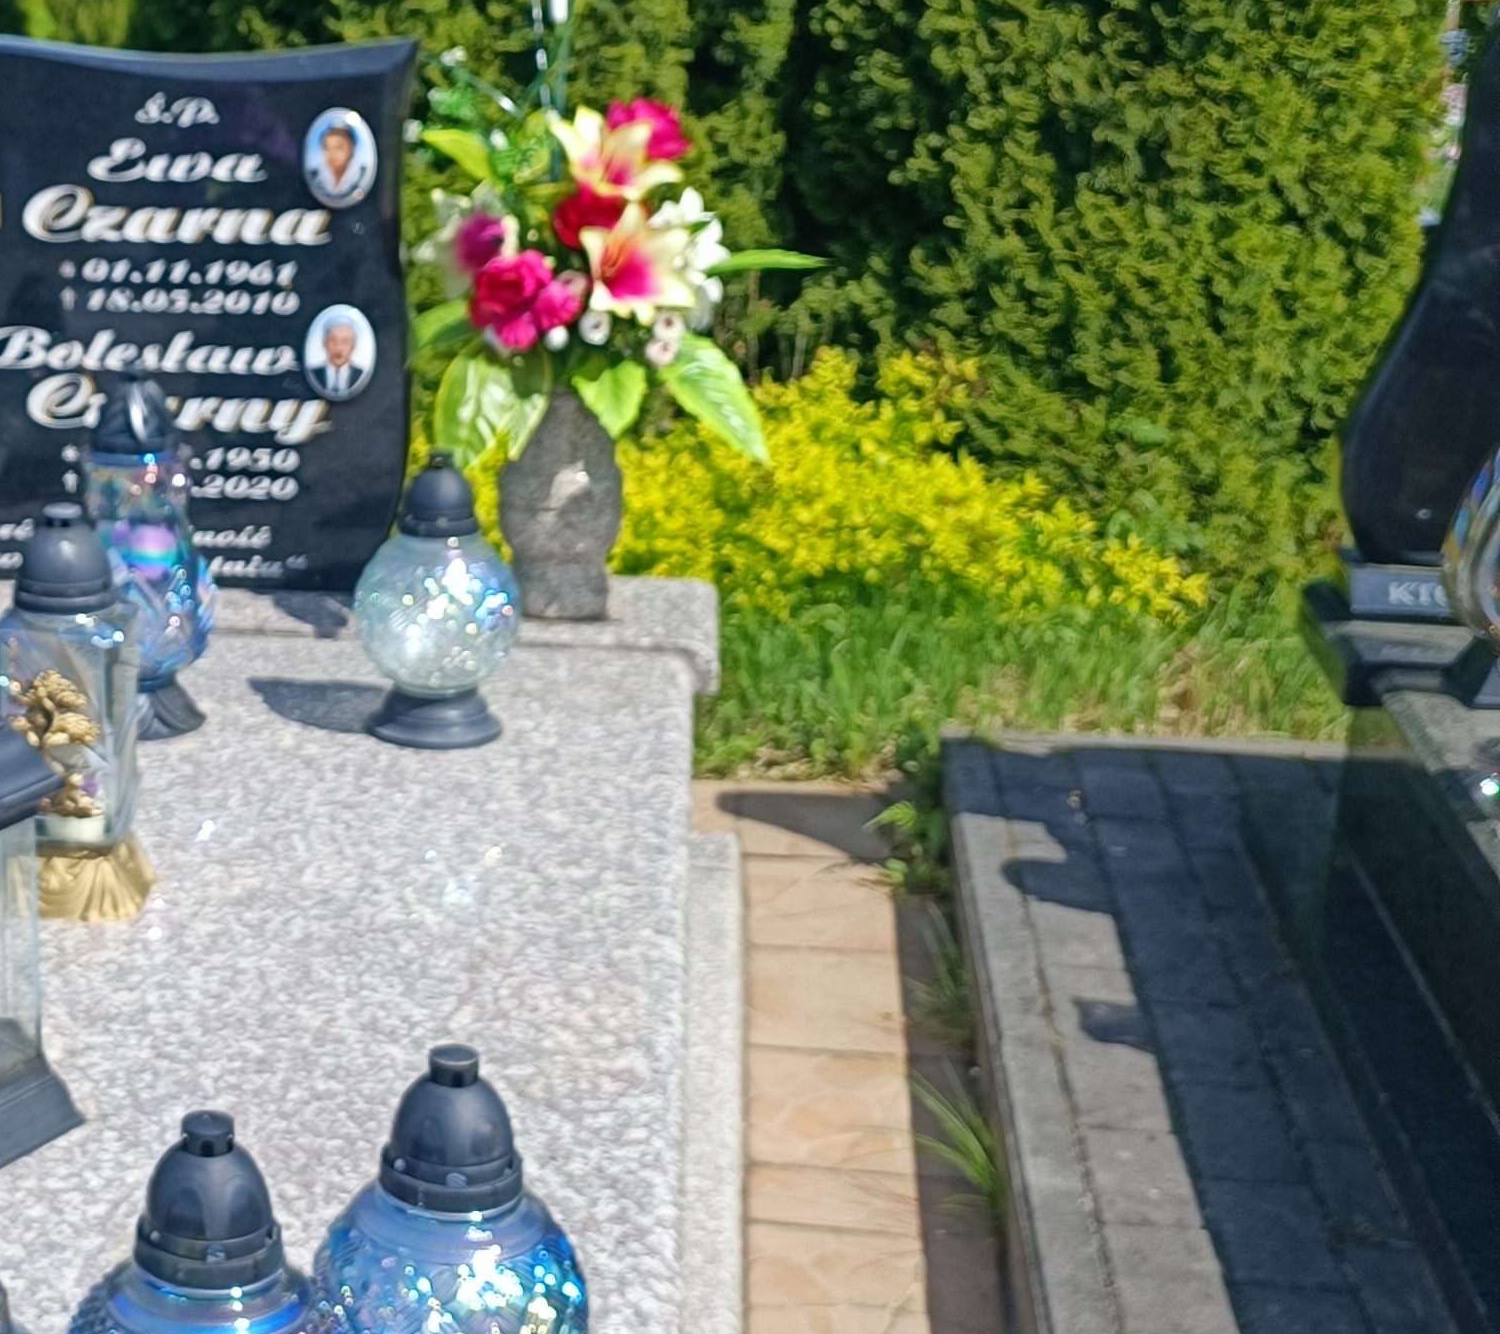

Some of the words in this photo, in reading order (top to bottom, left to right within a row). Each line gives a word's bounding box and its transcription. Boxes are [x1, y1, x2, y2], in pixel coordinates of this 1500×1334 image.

[87, 137, 268, 182] Ewa
[22, 184, 332, 245] Czarna
[81, 257, 298, 286] 01.11.1961
[26, 373, 334, 445] Crny
